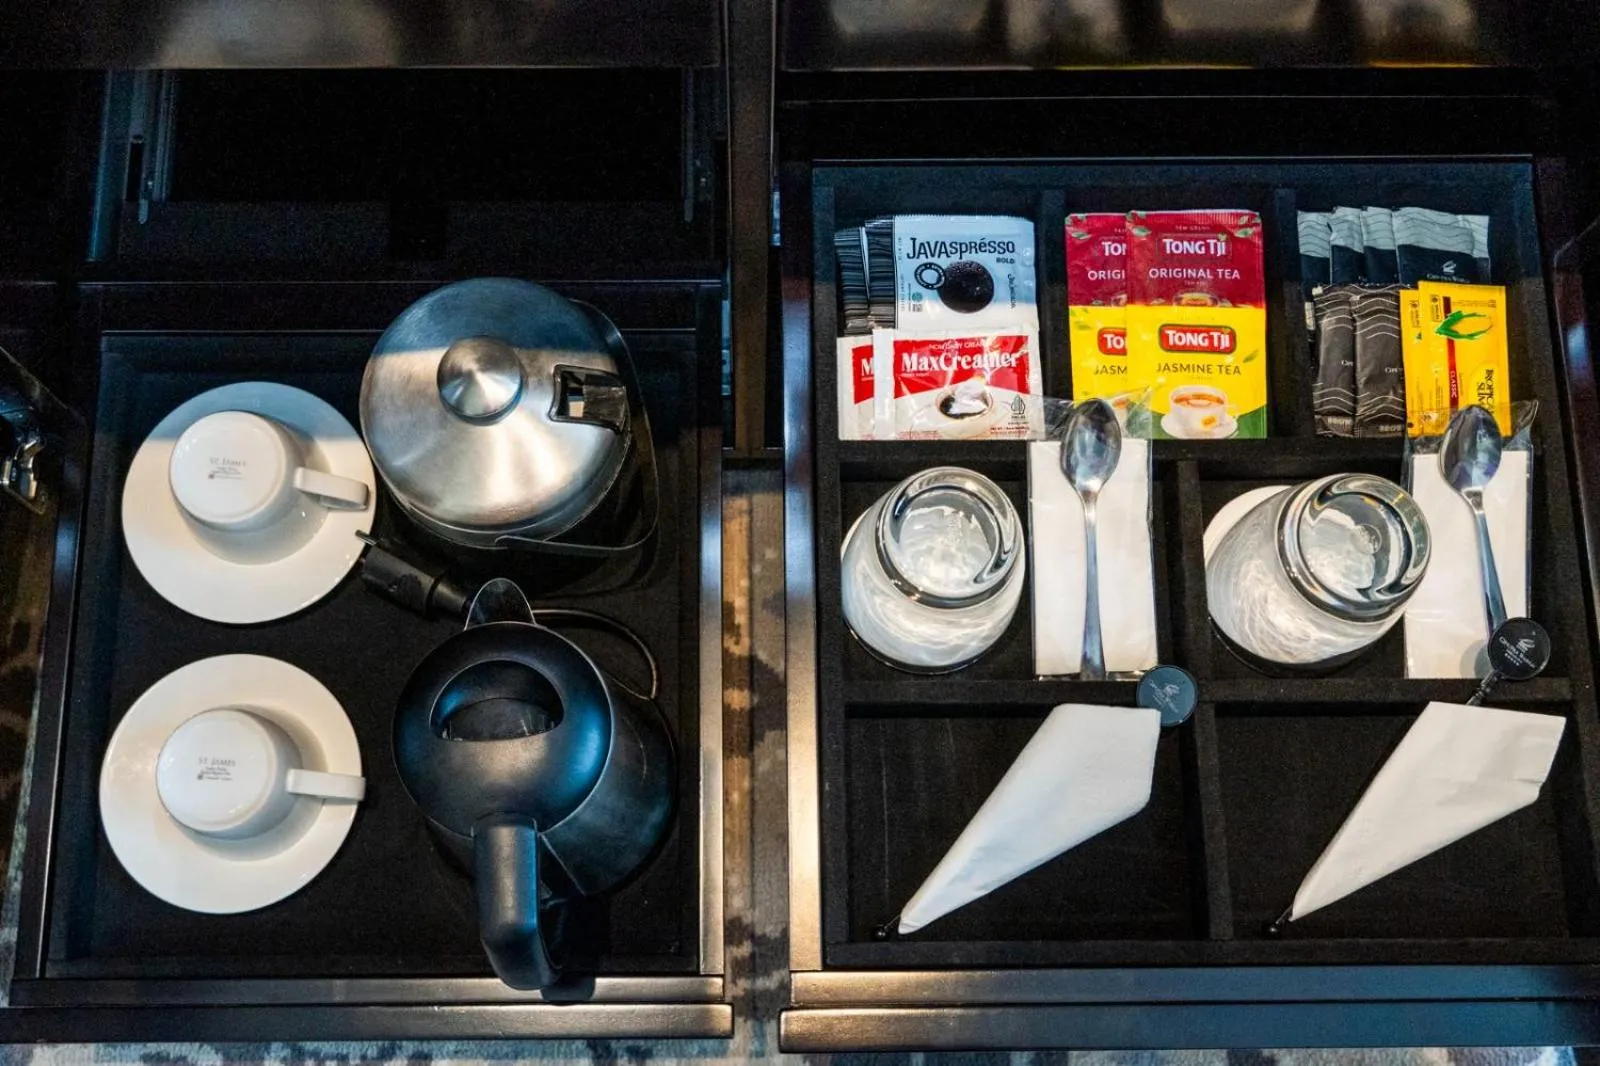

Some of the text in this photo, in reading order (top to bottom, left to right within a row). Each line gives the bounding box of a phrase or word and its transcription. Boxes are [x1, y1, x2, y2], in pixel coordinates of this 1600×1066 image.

[1102, 241, 1126, 256] TO
[1162, 238, 1205, 255] TONG
[996, 257, 1015, 265] BOLD
[1087, 269, 1125, 281] ORIGI
[1149, 268, 1241, 280] ORIGINAL TEA
[1103, 333, 1127, 349] TO
[1165, 329, 1209, 346] TONG
[901, 350, 1018, 372] MaxCreamer
[1093, 364, 1127, 376] JASM
[1156, 362, 1242, 375] JASMINE TEA
